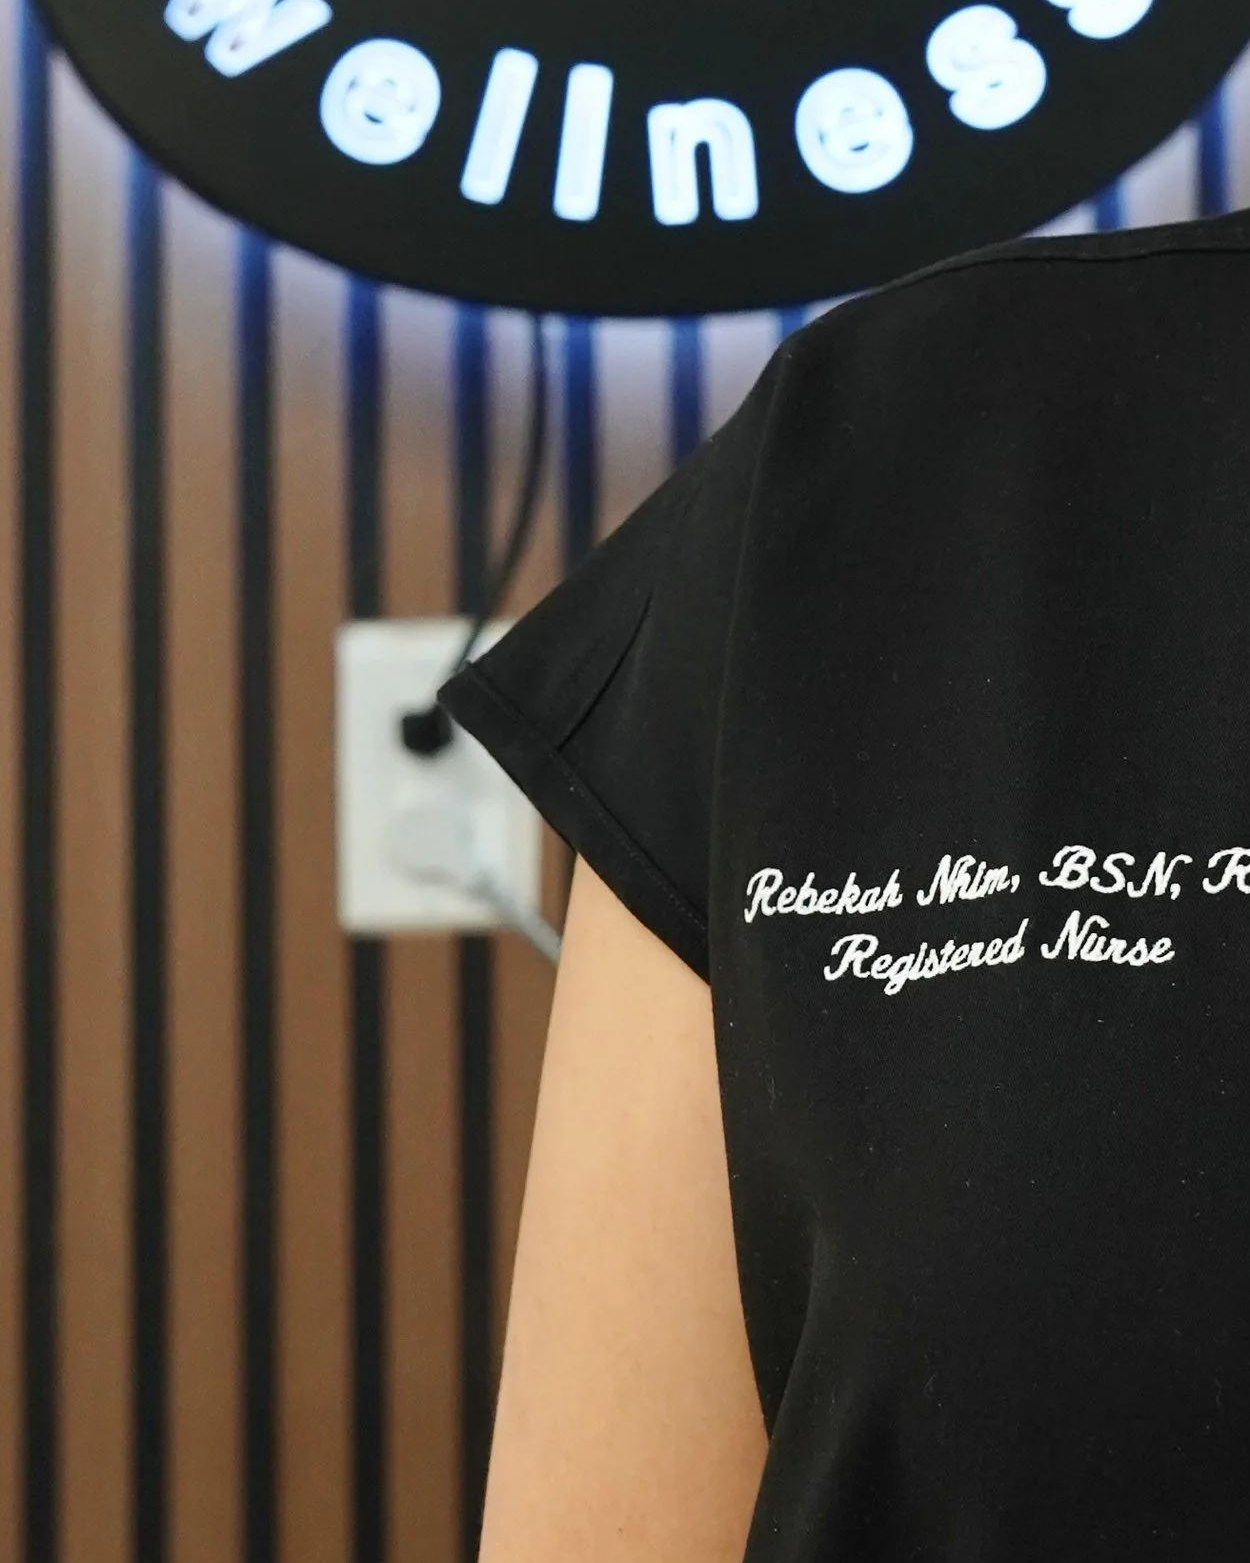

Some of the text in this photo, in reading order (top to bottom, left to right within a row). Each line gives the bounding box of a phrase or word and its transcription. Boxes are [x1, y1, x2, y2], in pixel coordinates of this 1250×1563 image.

[744, 867, 904, 924] Rebekah
[916, 854, 1021, 907] Nhim,
[1038, 844, 1193, 901] BSN,
[823, 909, 1176, 996] Registered Nurse
